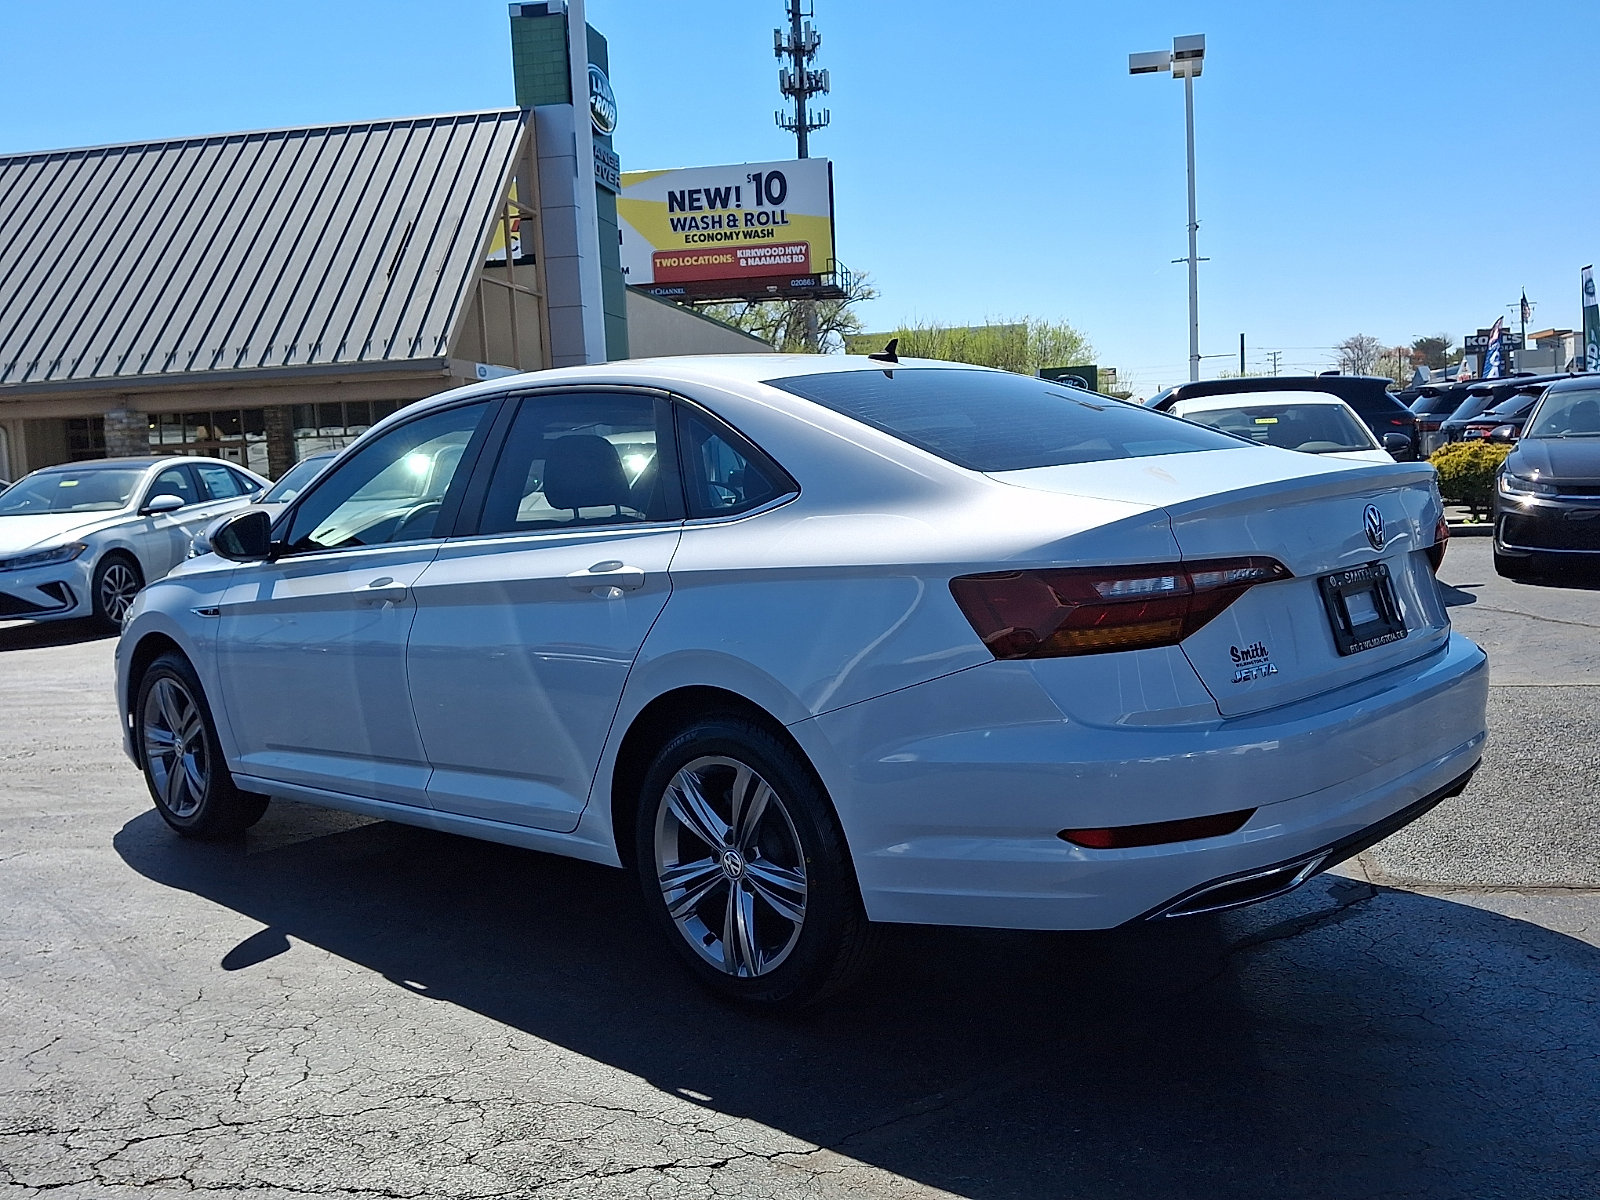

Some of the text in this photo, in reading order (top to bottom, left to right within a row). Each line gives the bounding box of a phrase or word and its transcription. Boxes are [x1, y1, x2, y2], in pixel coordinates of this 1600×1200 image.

[593, 146, 620, 170] ANGE
[594, 161, 621, 189] OVER
[667, 185, 742, 213] NEW!
[669, 209, 789, 233] WASH & ROLL
[684, 228, 775, 244] ECONOMY WASH
[655, 253, 735, 268] TWO LOCATIONS:
[736, 245, 807, 258] KIRKWOOD HWY
[739, 254, 805, 267] & NAAMANS RD
[1466, 334, 1522, 347] KOL'S
[1230, 641, 1269, 663] Smith
[1230, 663, 1279, 684] JETTA
